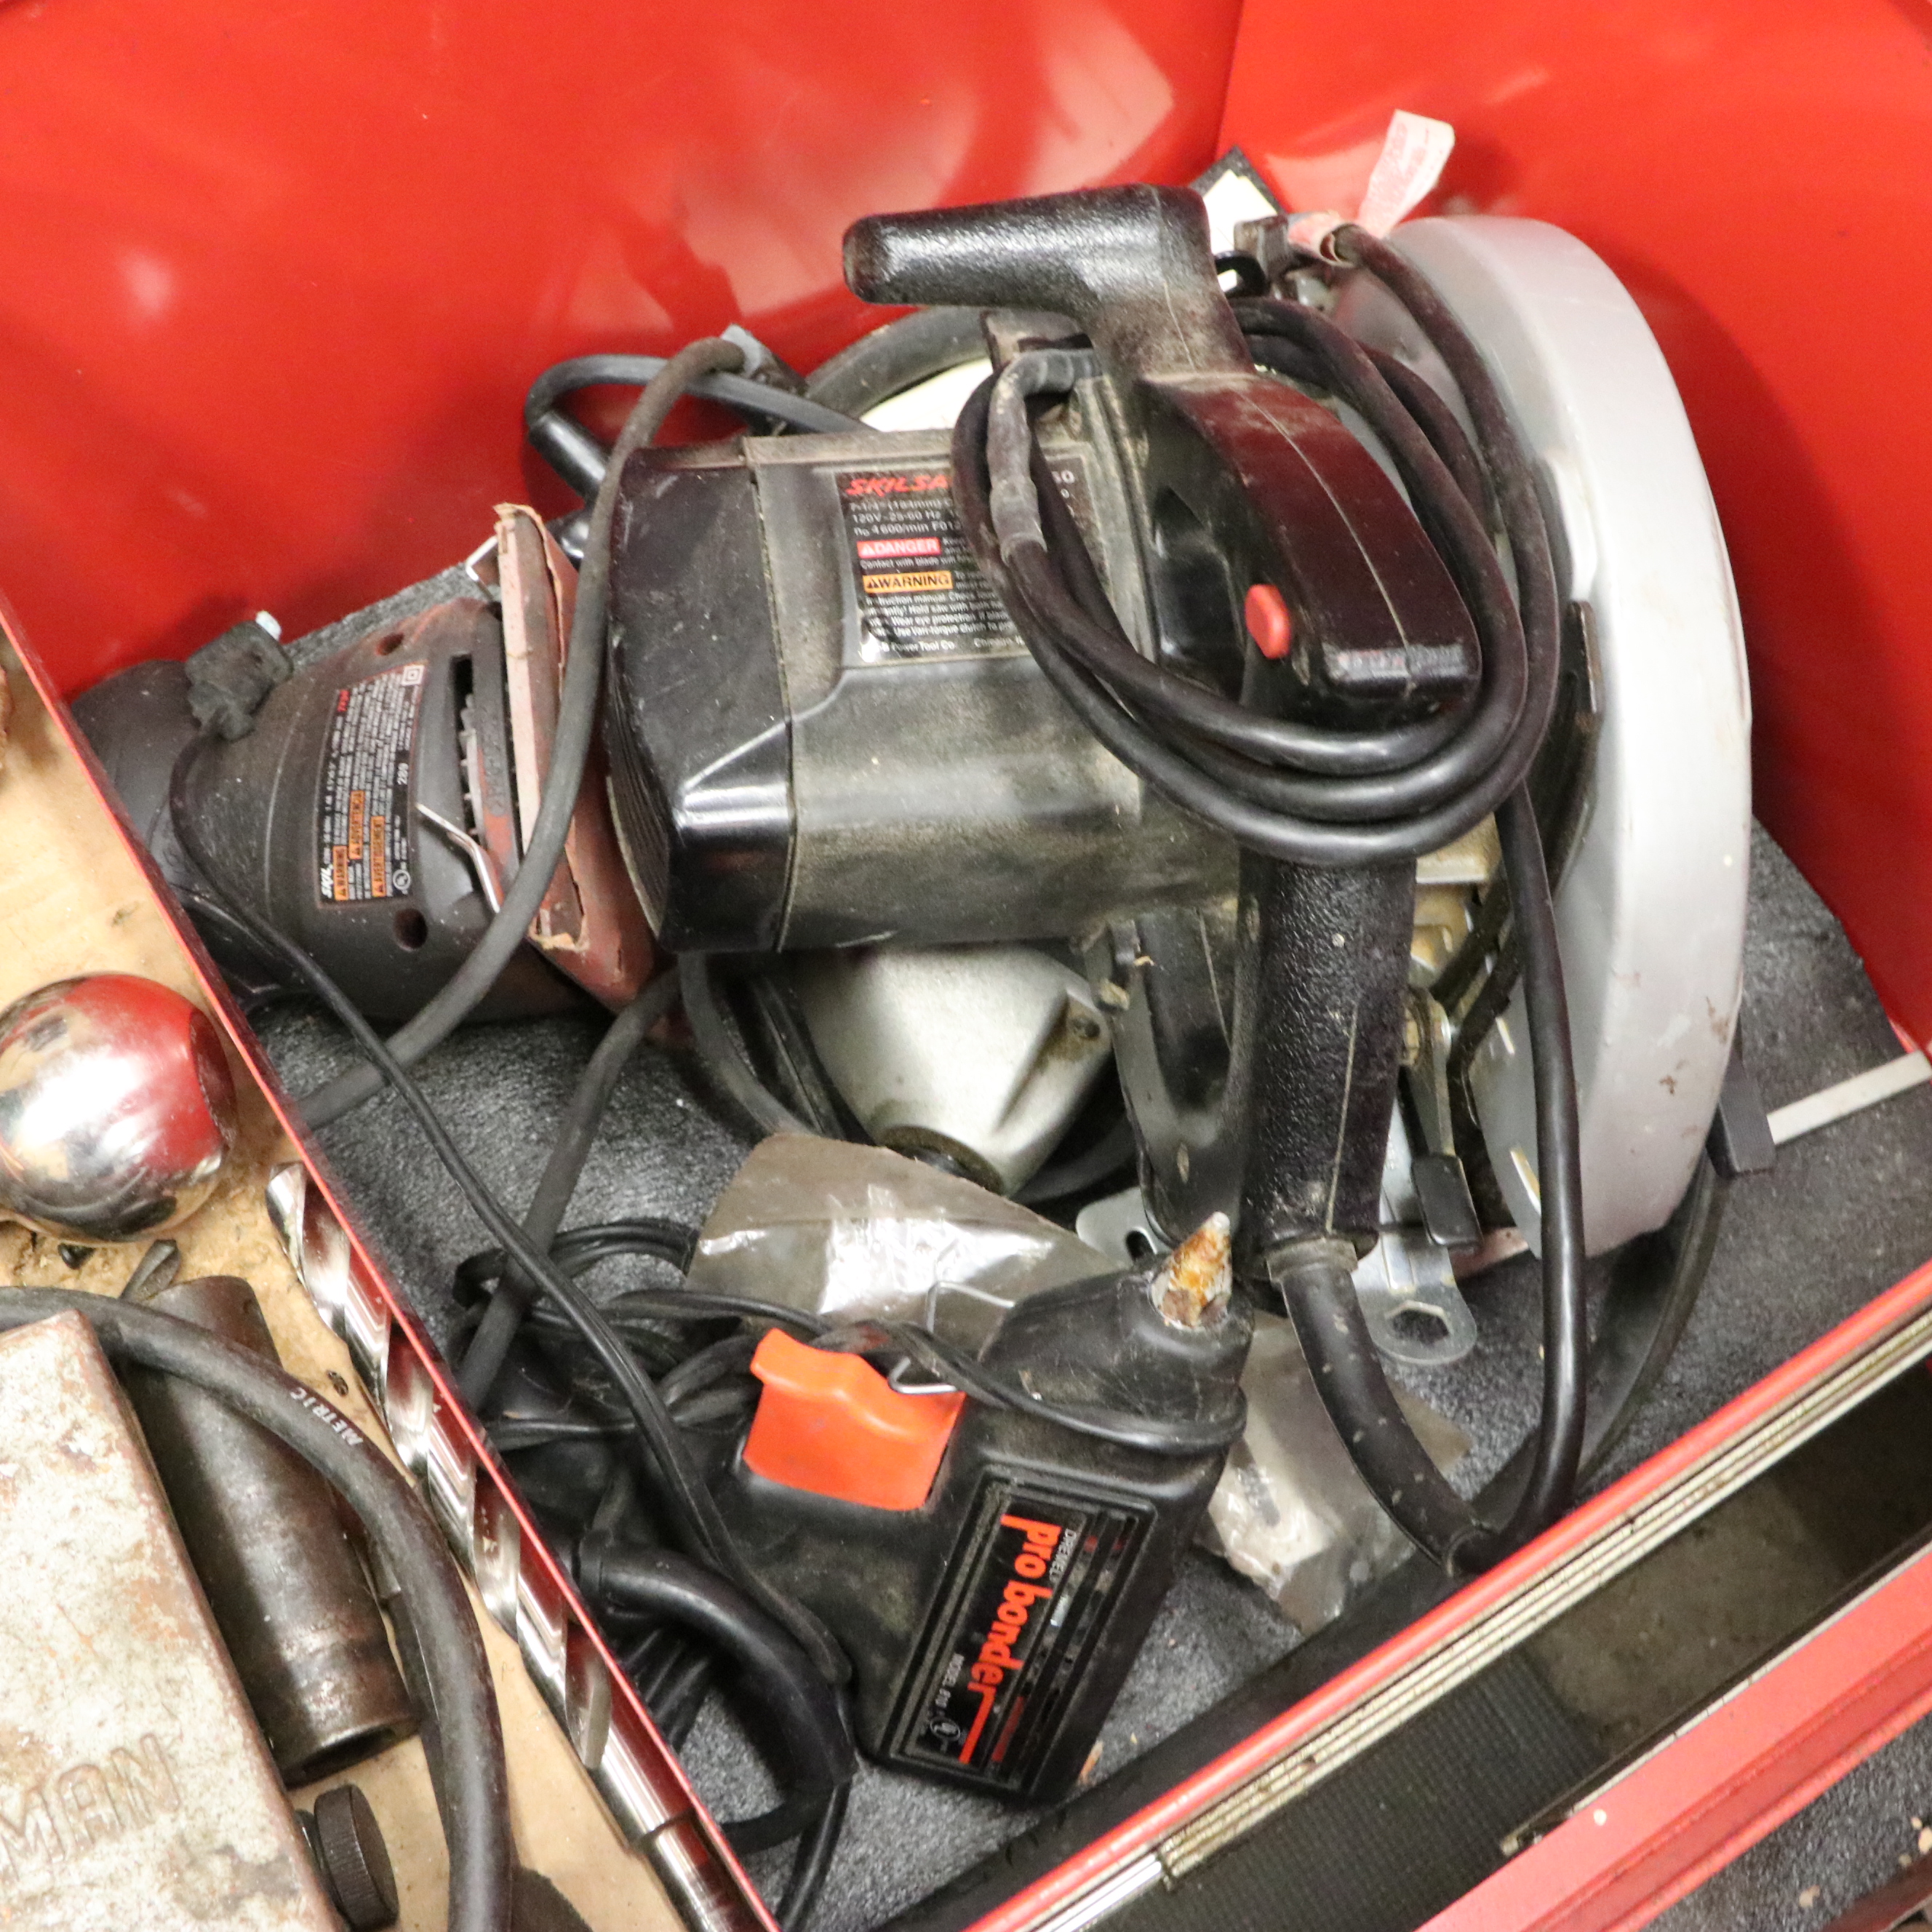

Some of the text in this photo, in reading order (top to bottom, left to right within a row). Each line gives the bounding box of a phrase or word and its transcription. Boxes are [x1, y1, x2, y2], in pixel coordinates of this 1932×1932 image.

[845, 475, 950, 497] SKILSA
[876, 538, 940, 556] DANGER
[879, 572, 949, 588] WARNING
[891, 615, 914, 626] Wear
[914, 615, 931, 626] eye
[919, 640, 940, 651] Tool
[320, 866, 334, 899] SKIL
[290, 1386, 364, 1446] METRIC
[1049, 1528, 1077, 1579] DREMEL
[959, 1513, 1063, 1764] pro bonder
